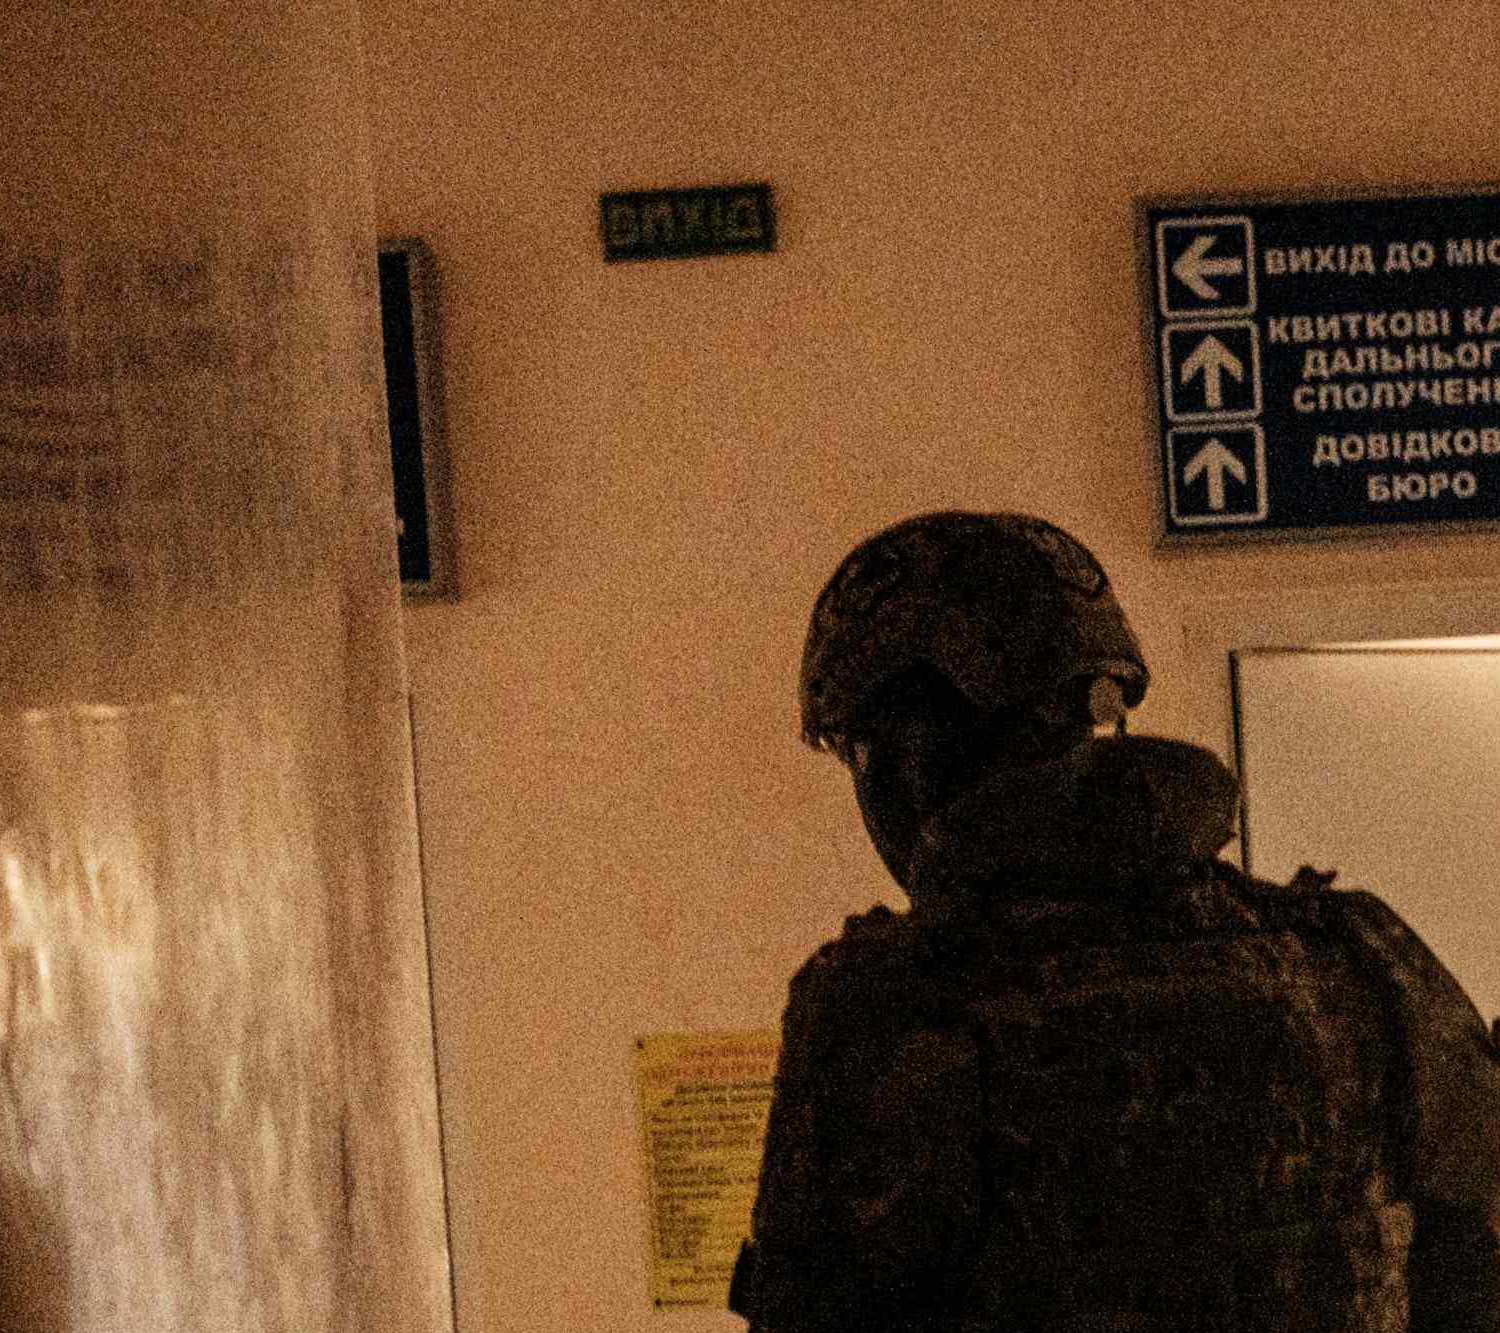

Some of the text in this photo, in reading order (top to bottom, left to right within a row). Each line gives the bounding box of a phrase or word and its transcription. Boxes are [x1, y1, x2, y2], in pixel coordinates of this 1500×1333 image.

[1264, 245, 1376, 277] ВИХІД
[1384, 240, 1435, 274] ДО
[1267, 309, 1451, 344] КВИТКОВІ
[1367, 472, 1477, 504] БЮРО
